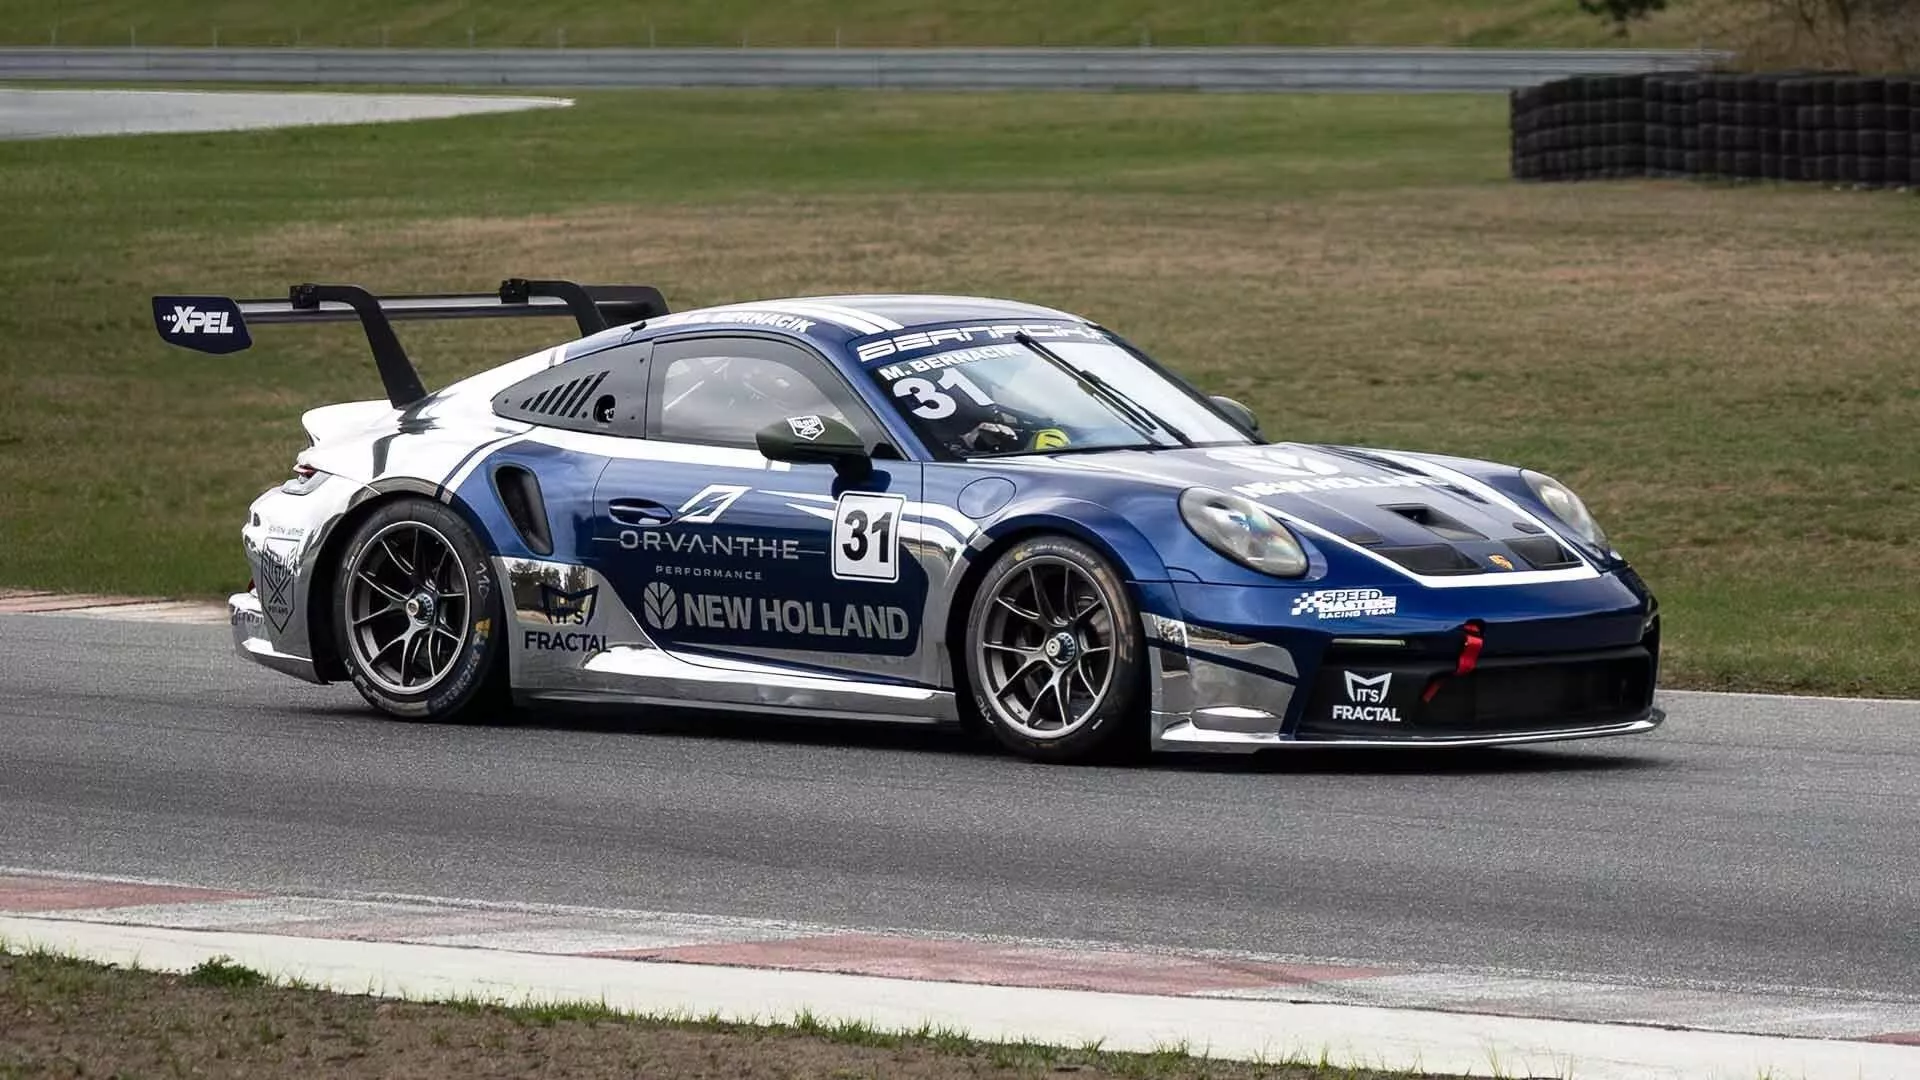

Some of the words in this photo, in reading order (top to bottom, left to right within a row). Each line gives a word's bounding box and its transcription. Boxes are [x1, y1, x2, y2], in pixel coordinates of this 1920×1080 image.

[170, 306, 234, 333] XPEL
[713, 310, 817, 333] RNACIK
[878, 366, 912, 381] M.
[893, 368, 995, 419] 31
[620, 530, 799, 560] ORVANTHE
[842, 509, 893, 563] 31
[655, 565, 763, 580] PERFORMANCE
[1322, 590, 1381, 602] SPEED
[683, 593, 752, 630] NEW
[759, 598, 909, 640] HOLLAND
[1318, 609, 1361, 620] RACING
[1365, 608, 1396, 616] TEAM
[525, 631, 612, 653] FRACTAL
[1356, 688, 1380, 703] IT'S
[1332, 705, 1402, 722] FRACTAL
